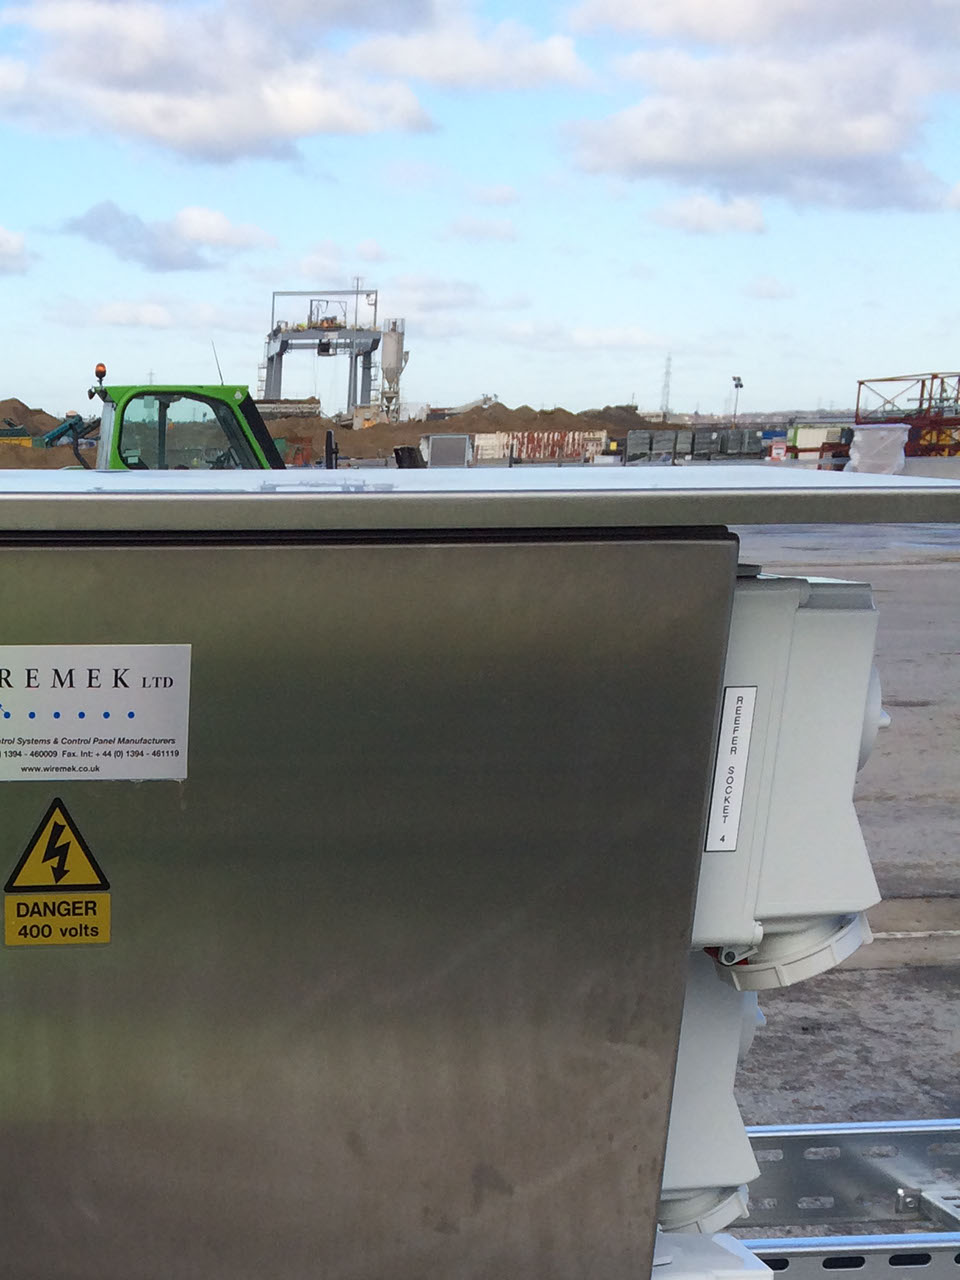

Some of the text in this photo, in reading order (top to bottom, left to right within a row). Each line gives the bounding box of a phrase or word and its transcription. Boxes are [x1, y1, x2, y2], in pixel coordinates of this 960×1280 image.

[141, 676, 174, 689] LTD
[16, 737, 51, 746] Systems
[52, 737, 59, 745] &
[60, 737, 91, 745] Control
[92, 737, 116, 745] Panel
[117, 737, 177, 745] Manufacturers
[3, 750, 22, 758] 1394
[29, 750, 58, 758] 460009
[61, 750, 78, 758] Fax.
[80, 750, 94, 758] Int:
[113, 750, 124, 759] (0)
[126, 750, 144, 758] 1394
[151, 750, 180, 758] 461119
[20, 765, 100, 773] www.wiremek.co.uk
[719, 695, 744, 843] REEFER SOCKET 4
[16, 900, 97, 918] DANGER
[18, 923, 99, 938] 400 volts
